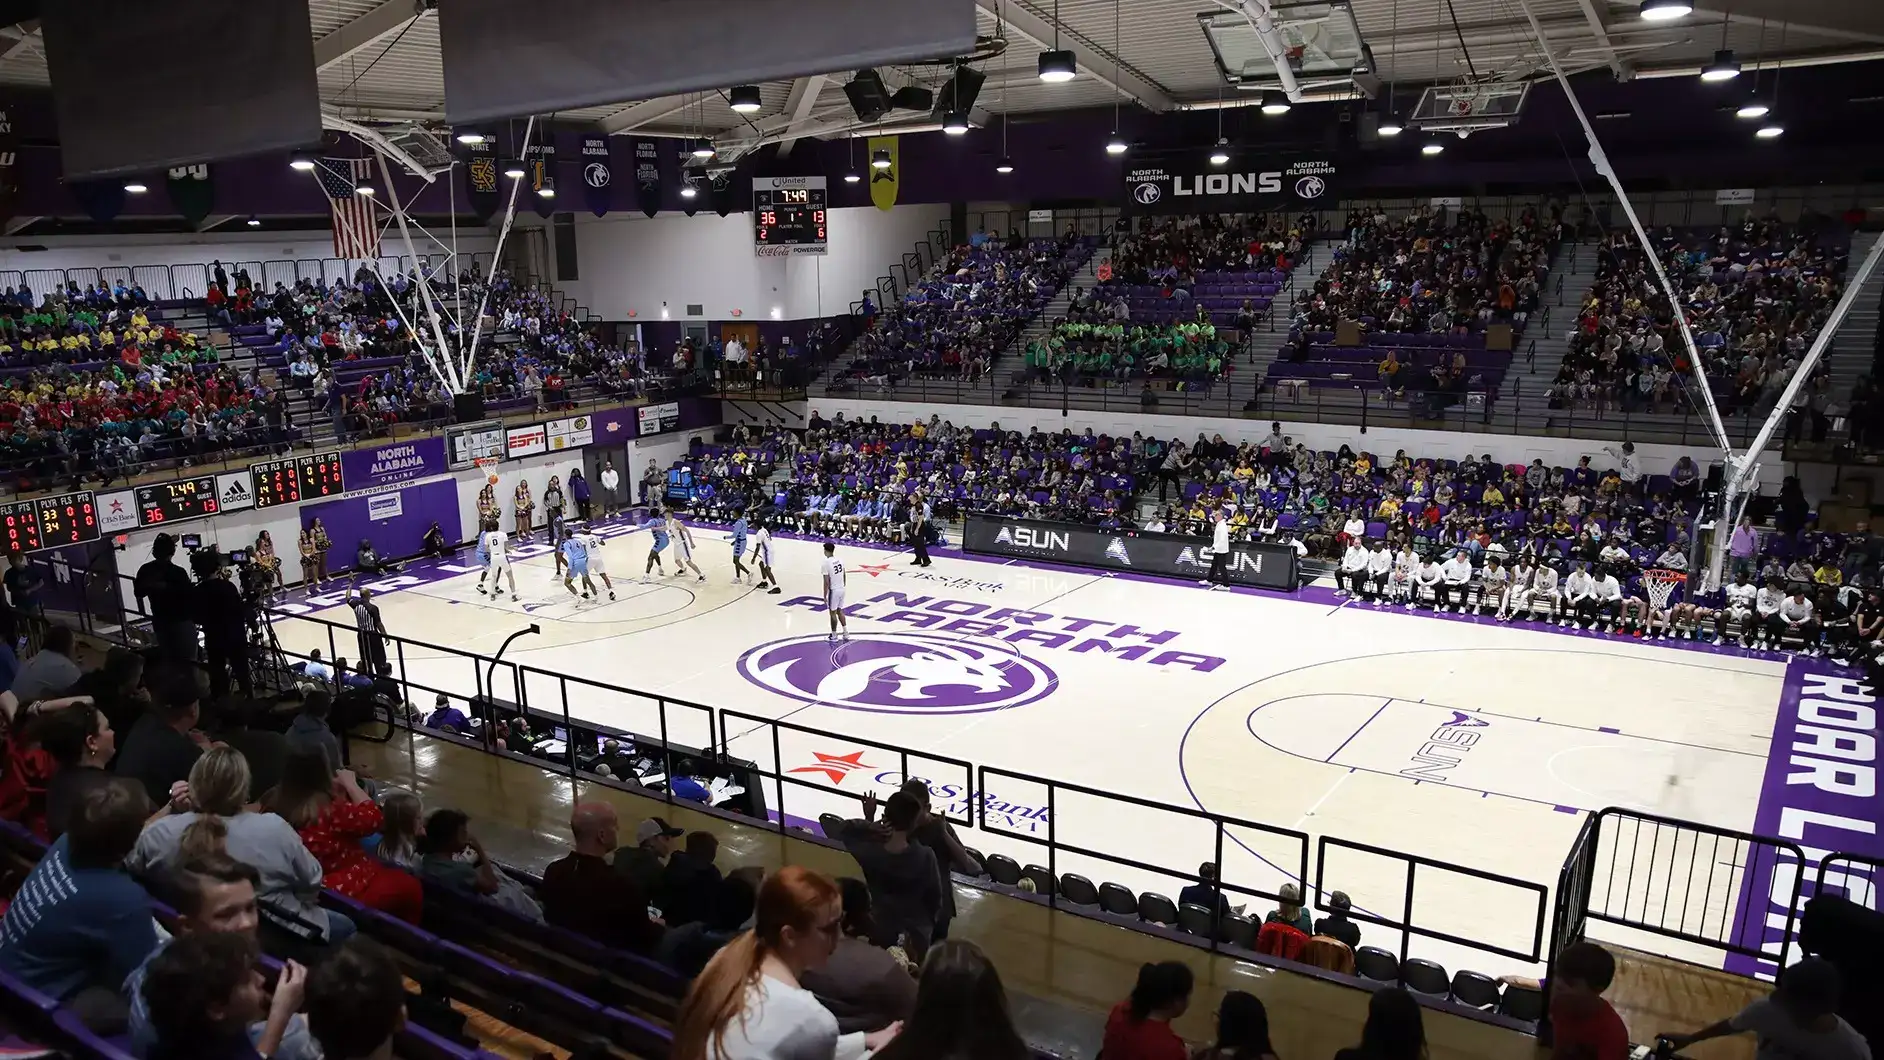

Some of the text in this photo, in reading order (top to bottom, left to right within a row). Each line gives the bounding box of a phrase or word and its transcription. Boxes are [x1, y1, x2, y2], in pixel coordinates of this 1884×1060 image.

[583, 147, 608, 155] ALABAMA
[1286, 166, 1335, 175] ALABAMA
[1174, 172, 1282, 196] LIONS
[782, 190, 807, 202] 7:49
[761, 211, 824, 224] 36 1 13
[761, 228, 824, 239] 2 6
[508, 432, 544, 449] ESPN
[376, 445, 415, 461] NORTH
[307, 462, 338, 475] 0 0 2
[371, 456, 424, 473] ALABAMA
[261, 469, 294, 483] 5 2 0
[334, 473, 340, 481] 0
[381, 471, 413, 482] ONLINE
[167, 482, 195, 497] 7:49
[260, 486, 269, 494] 14
[276, 483, 282, 491] 0
[322, 486, 328, 494] 6
[342, 480, 415, 498] www.roarlions.com
[41, 494, 89, 508] PLYR FLS PTS
[222, 492, 251, 504] adidas
[259, 497, 270, 506] 21
[290, 491, 297, 500] 0
[0, 503, 31, 515] FLS PTS
[143, 501, 157, 509] HOME
[146, 508, 163, 522] 36
[203, 500, 216, 512] 13
[43, 504, 91, 520] 33 0 0
[102, 514, 118, 524] CB&S
[118, 512, 135, 522] Bank
[7, 514, 33, 526] 0 11
[46, 522, 60, 533] 34
[86, 516, 93, 526] 0
[9, 529, 17, 539] 0
[71, 531, 78, 540] 2
[994, 526, 1069, 551] ASUN
[492, 538, 498, 547] 0
[834, 564, 843, 575] 33
[866, 590, 1182, 646] NORTH
[776, 596, 1228, 673] ALABAMA
[1786, 673, 1876, 797] ROAR
[959, 790, 1050, 822] Bank
